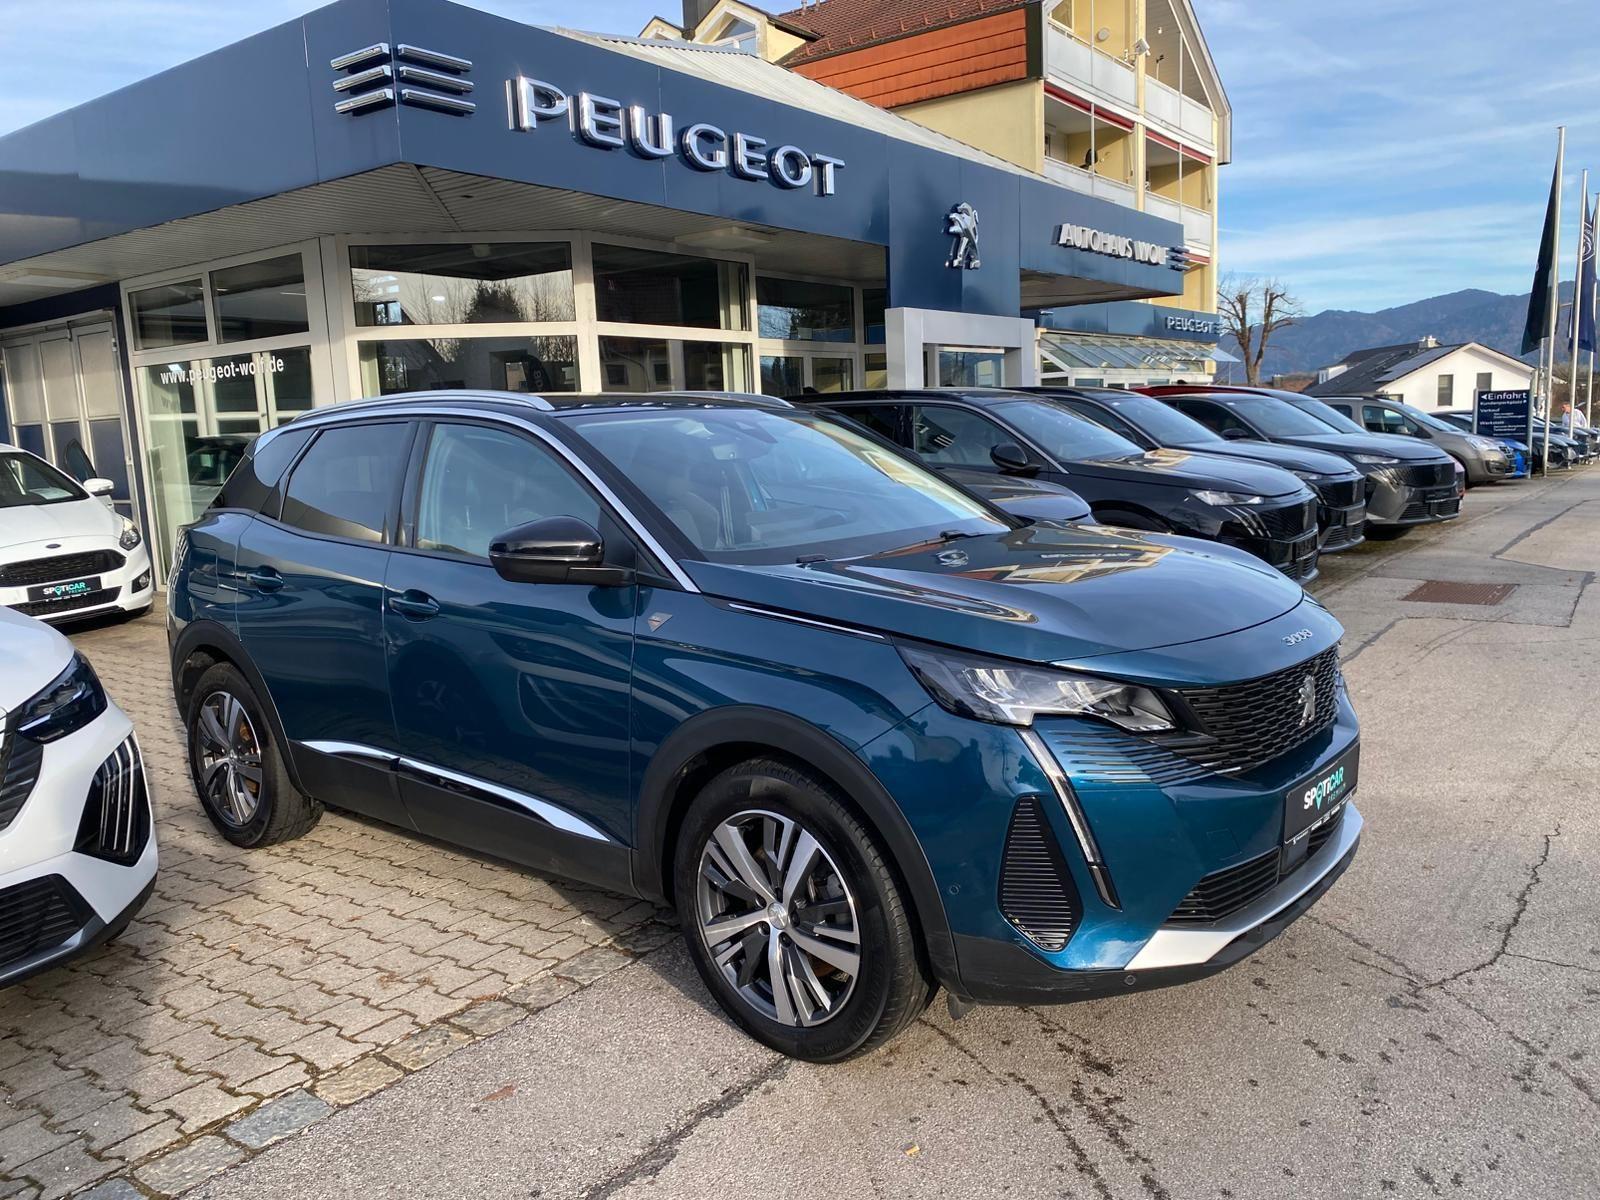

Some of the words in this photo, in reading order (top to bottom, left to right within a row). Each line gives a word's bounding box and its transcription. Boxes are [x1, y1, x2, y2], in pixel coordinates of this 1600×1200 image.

[506, 76, 845, 196] PEUGEOT
[1058, 223, 1133, 258] AUTOHAUS
[1166, 316, 1214, 334] PEUGEOT
[159, 356, 284, 385] www.peugeot-wolf.de
[1488, 392, 1527, 400] Einfahrt
[1282, 628, 1312, 646] 3008
